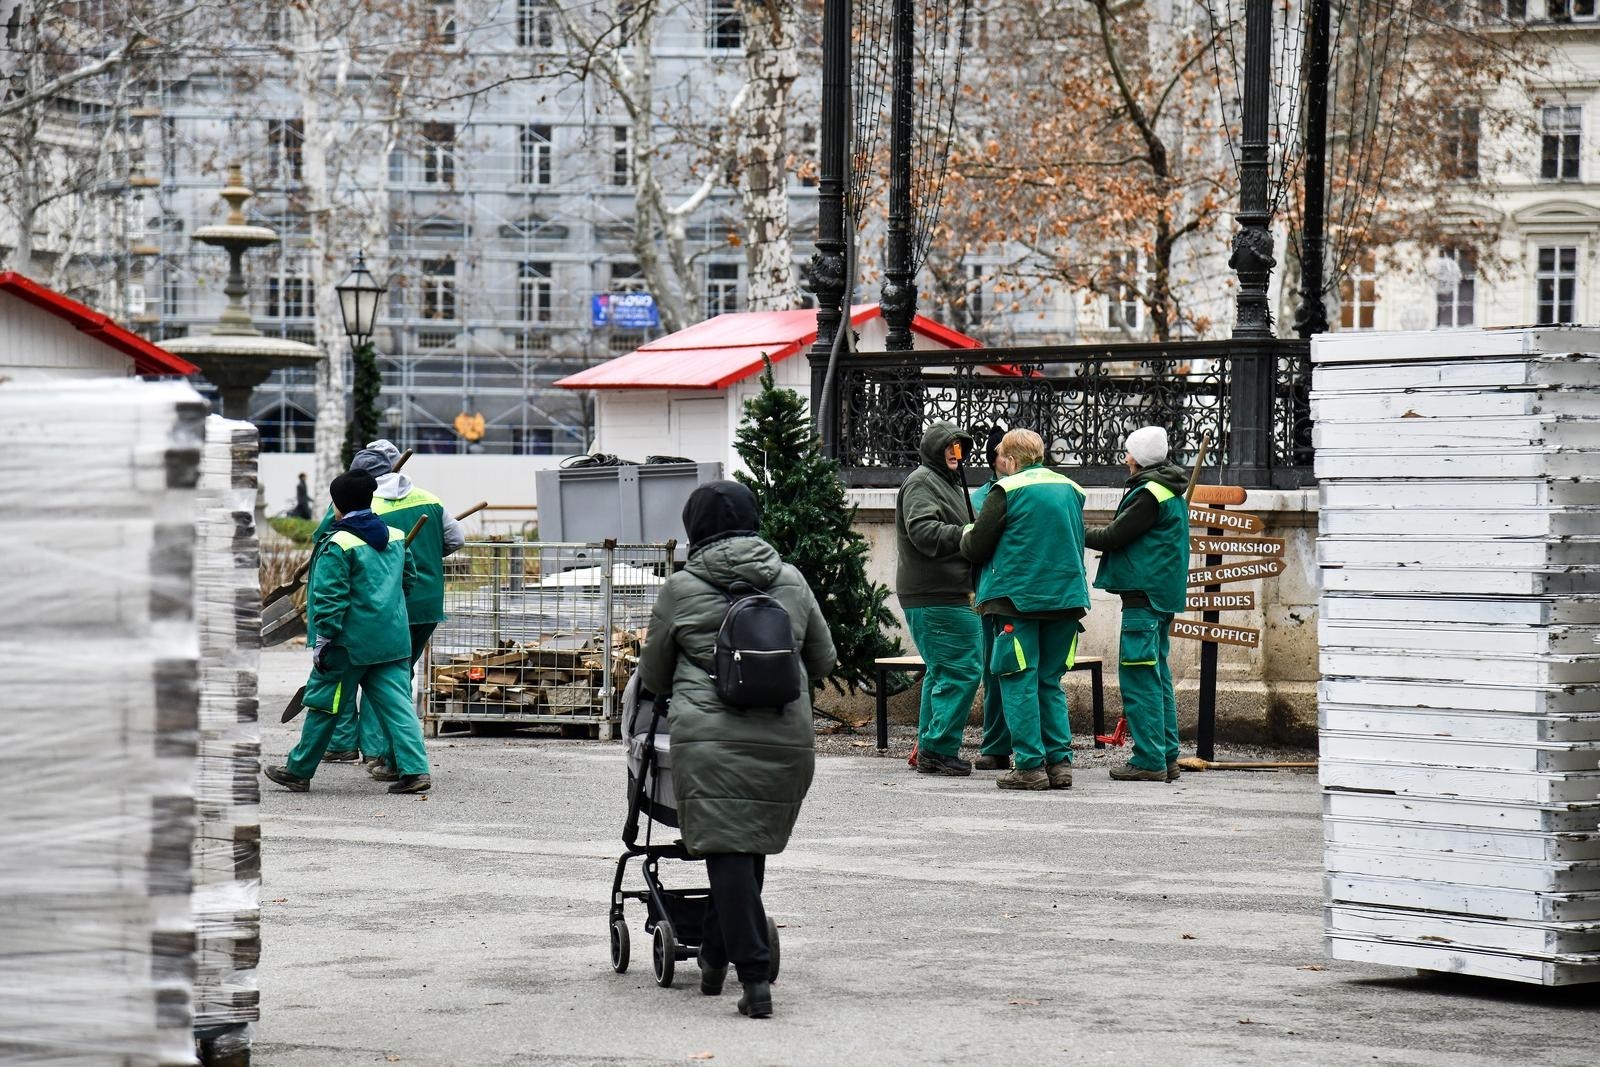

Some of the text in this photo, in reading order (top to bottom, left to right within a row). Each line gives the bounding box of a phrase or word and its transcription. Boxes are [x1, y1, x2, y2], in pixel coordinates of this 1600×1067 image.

[1188, 510, 1253, 530] RTH POLE
[1209, 541, 1281, 554] WORKSHOP
[1215, 562, 1278, 580] CROSSING
[1185, 595, 1251, 607] IGH RIDES
[1174, 622, 1256, 643] POST OFFICE
